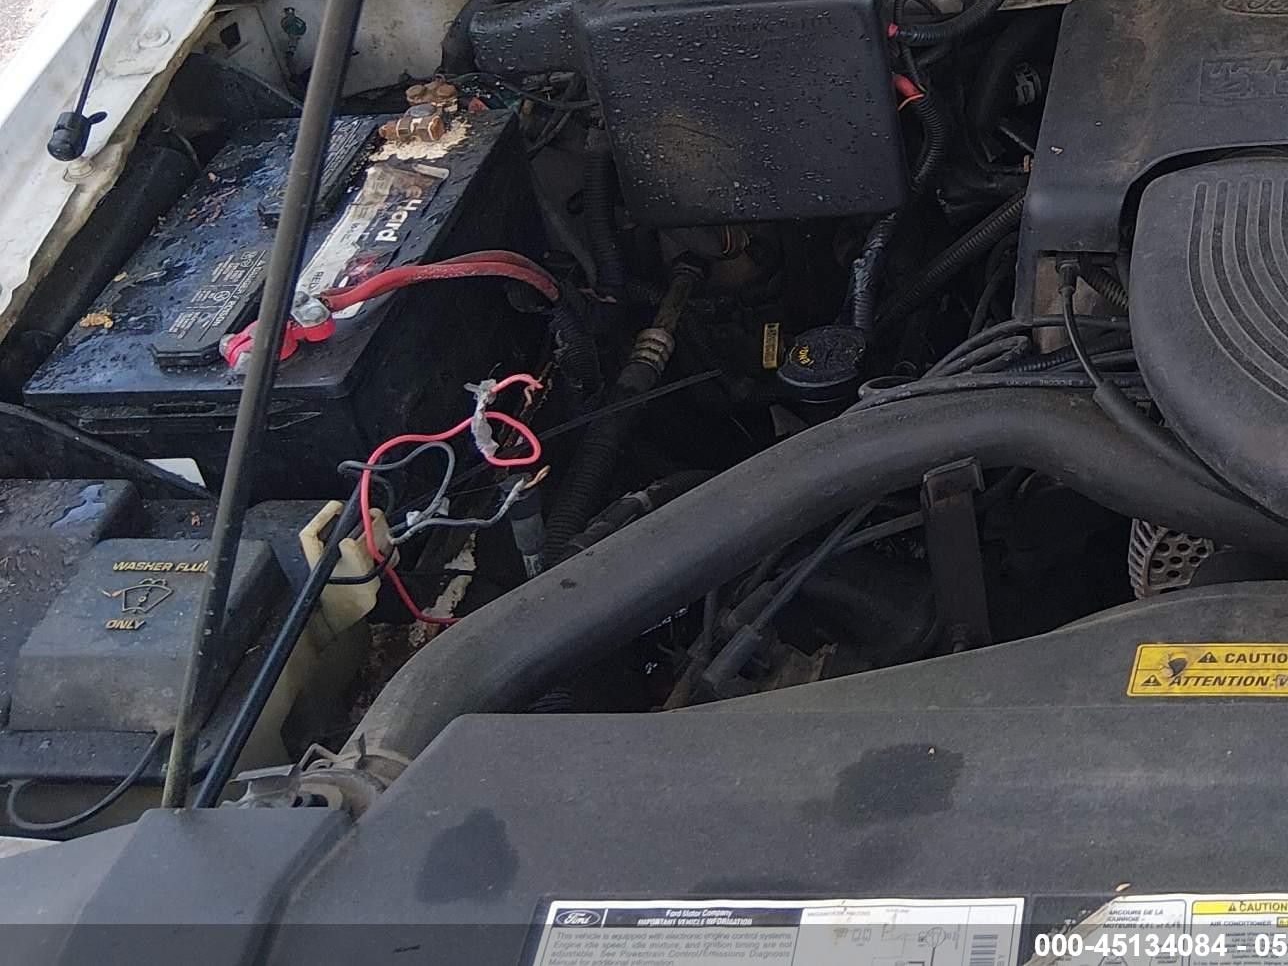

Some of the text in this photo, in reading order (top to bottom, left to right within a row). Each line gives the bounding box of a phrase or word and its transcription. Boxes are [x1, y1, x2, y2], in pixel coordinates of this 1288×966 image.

[112, 560, 209, 572] WASHER FLUI
[105, 619, 147, 631] ONLY
[1239, 901, 1288, 912] CAUTION
[666, 909, 734, 918] Ford Motor Company
[637, 917, 753, 926] IMPORTANT VEHICLE INFORMATION
